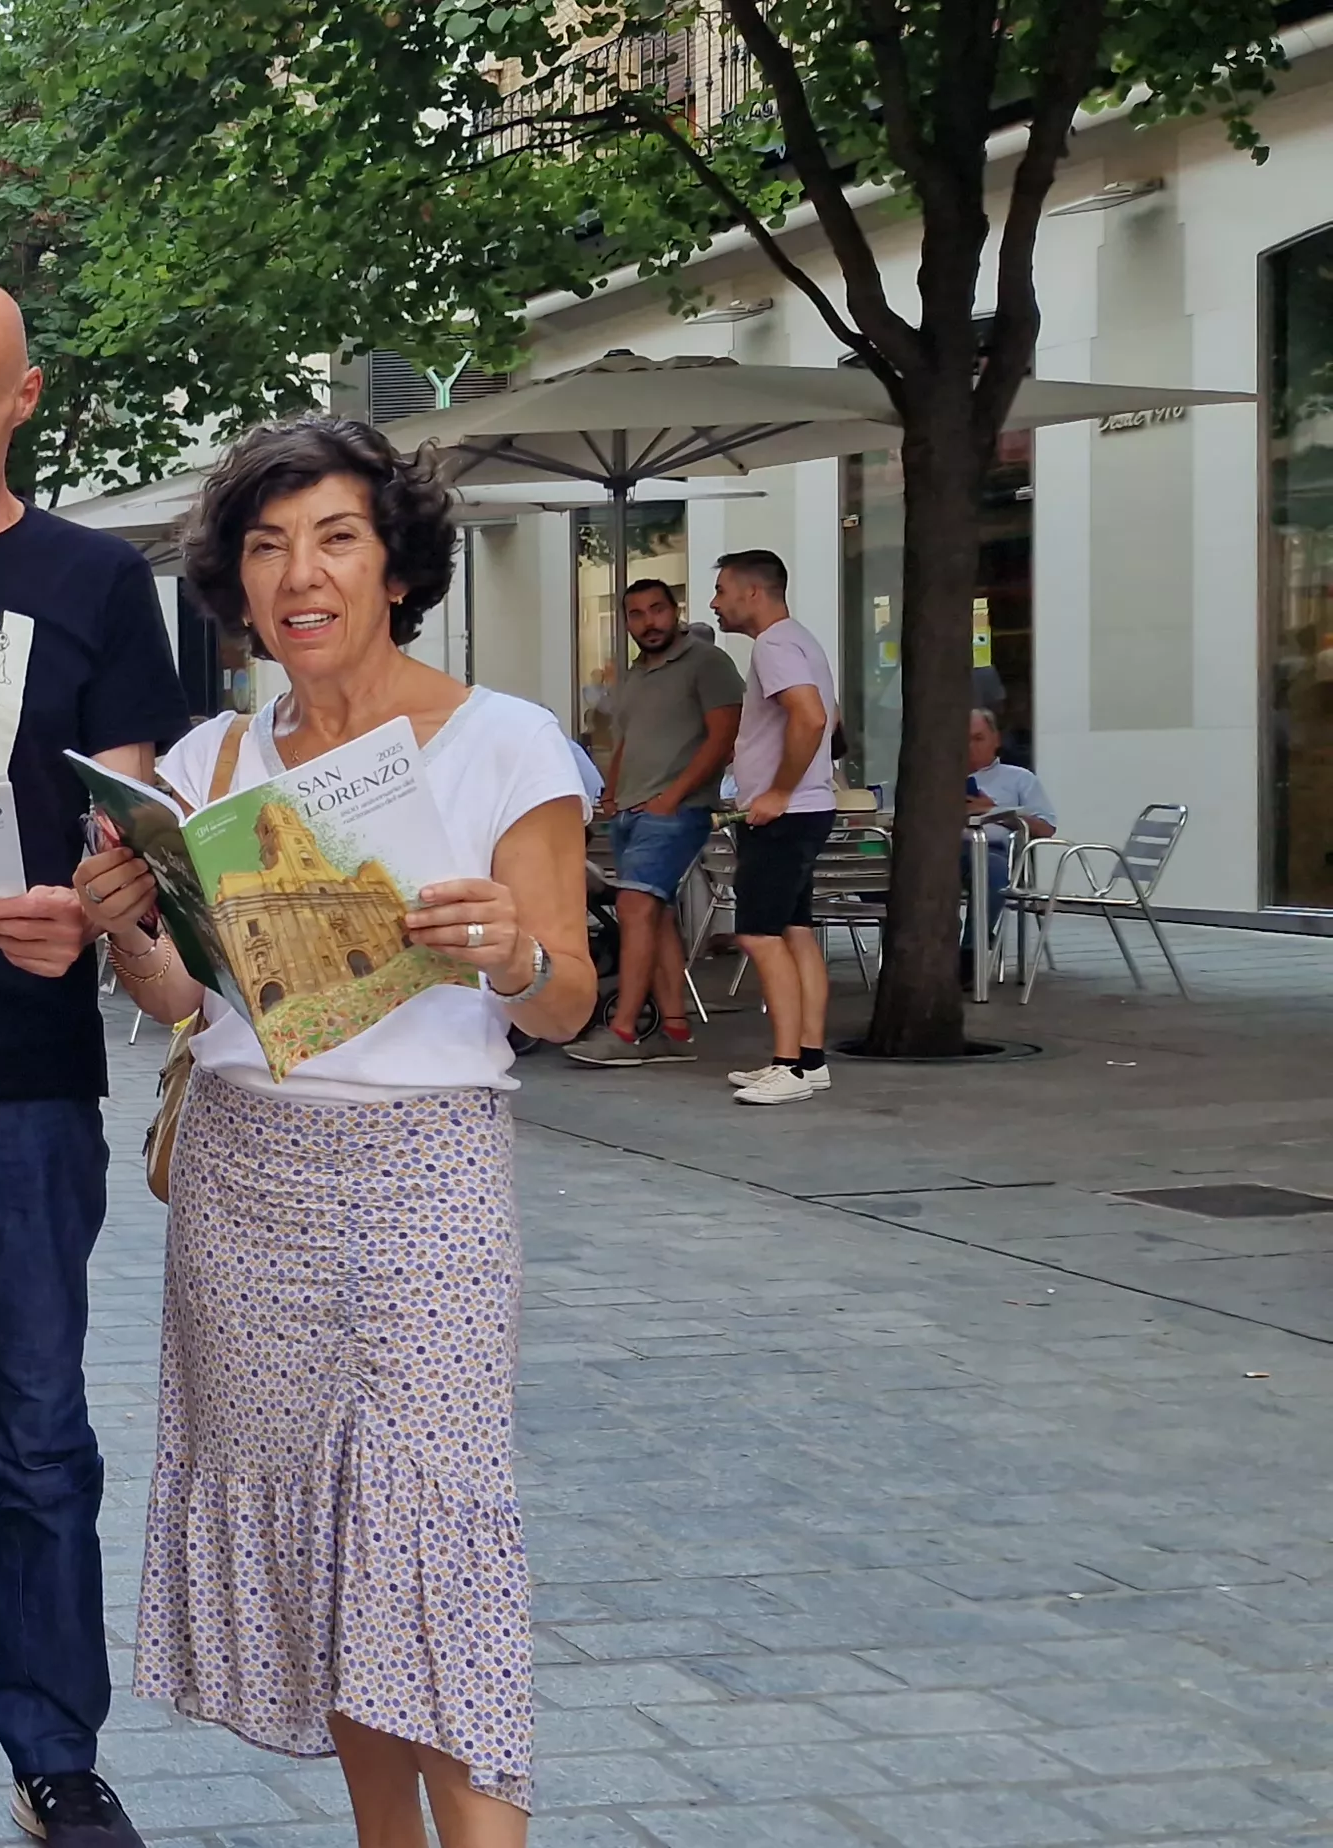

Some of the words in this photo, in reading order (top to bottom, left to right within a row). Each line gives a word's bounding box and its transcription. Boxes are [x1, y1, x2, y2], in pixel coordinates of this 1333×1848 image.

[376, 741, 404, 762] 2025
[297, 765, 342, 799] SAN
[304, 757, 410, 818] LORENZO
